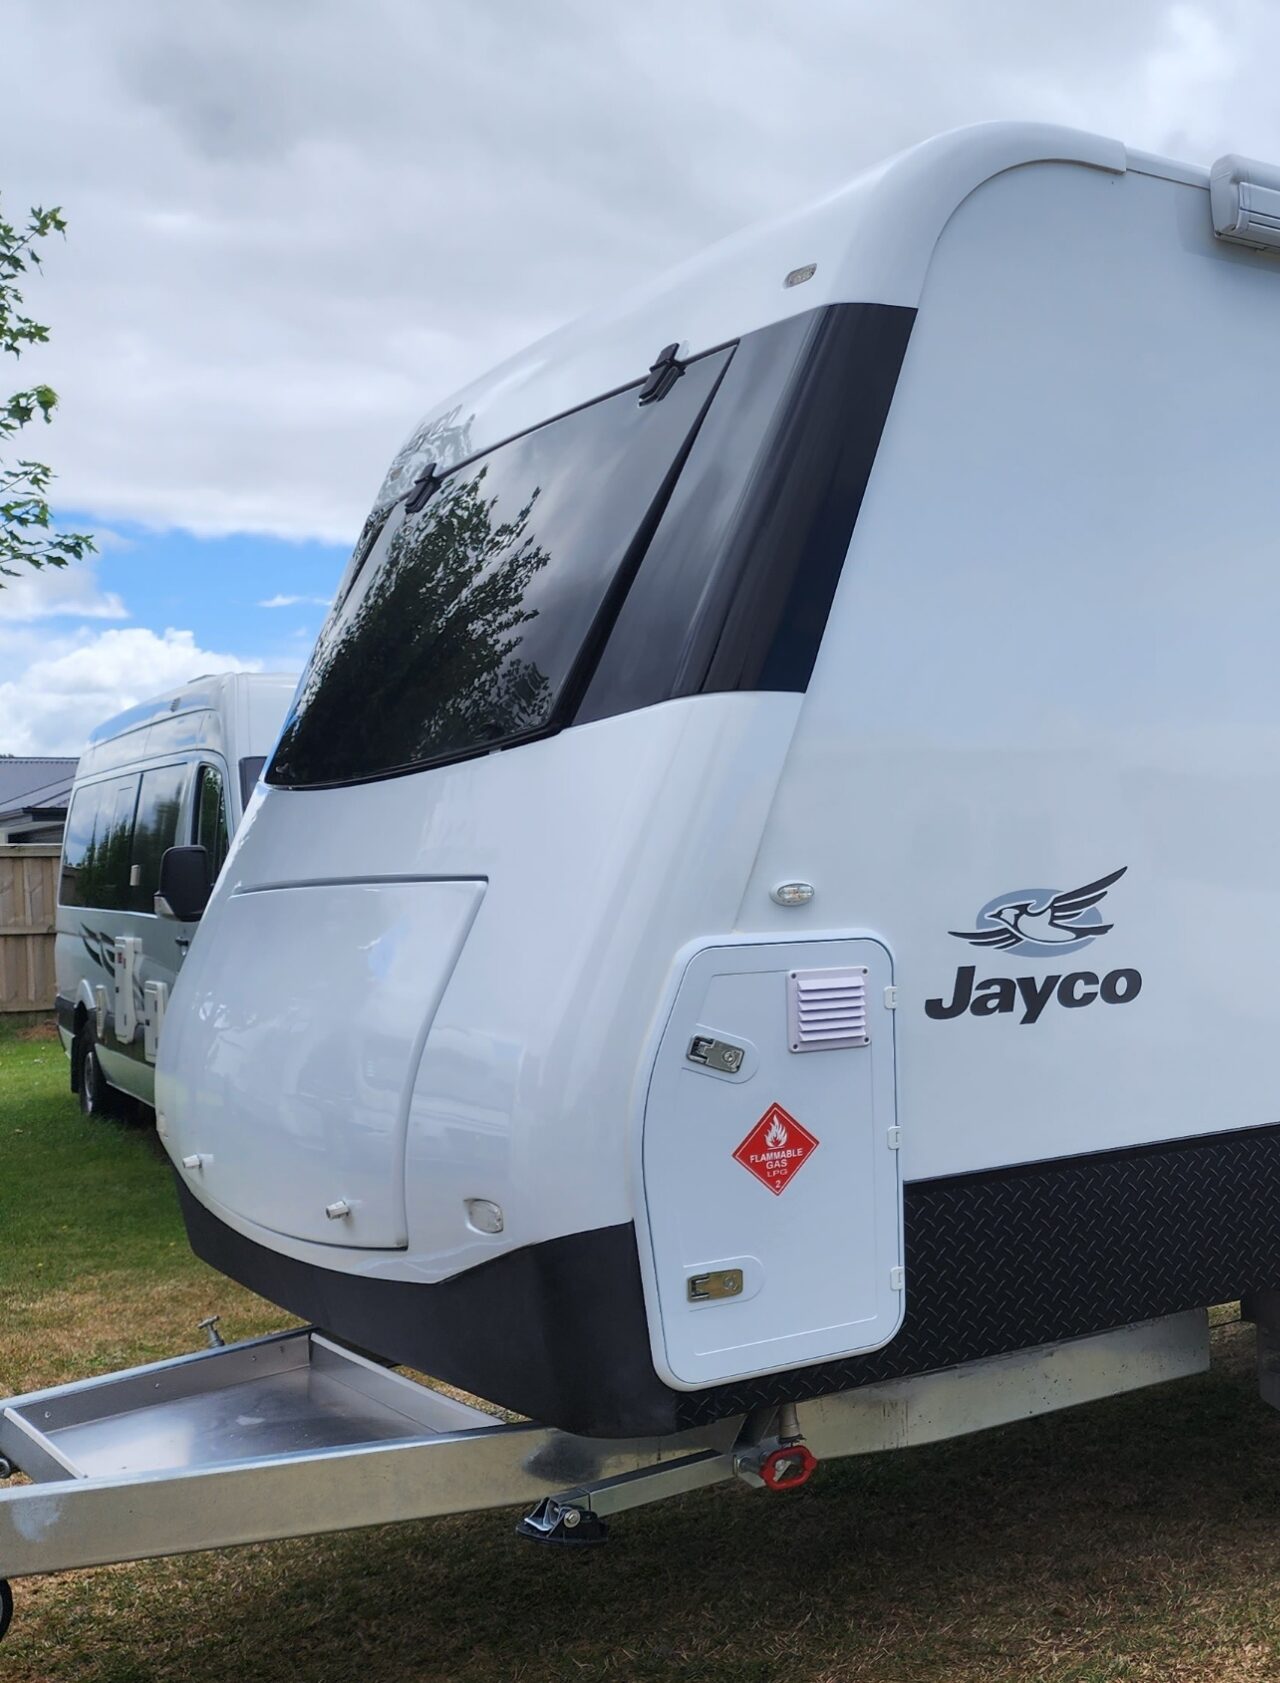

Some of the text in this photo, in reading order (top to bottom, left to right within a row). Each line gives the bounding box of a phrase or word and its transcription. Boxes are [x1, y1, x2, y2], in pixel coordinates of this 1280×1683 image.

[925, 965, 1142, 1025] Jayco
[749, 1148, 804, 1163] FLAMMABLE
[766, 1159, 788, 1170] GAS
[767, 1168, 788, 1178] LPG
[775, 1179, 781, 1188] 2
